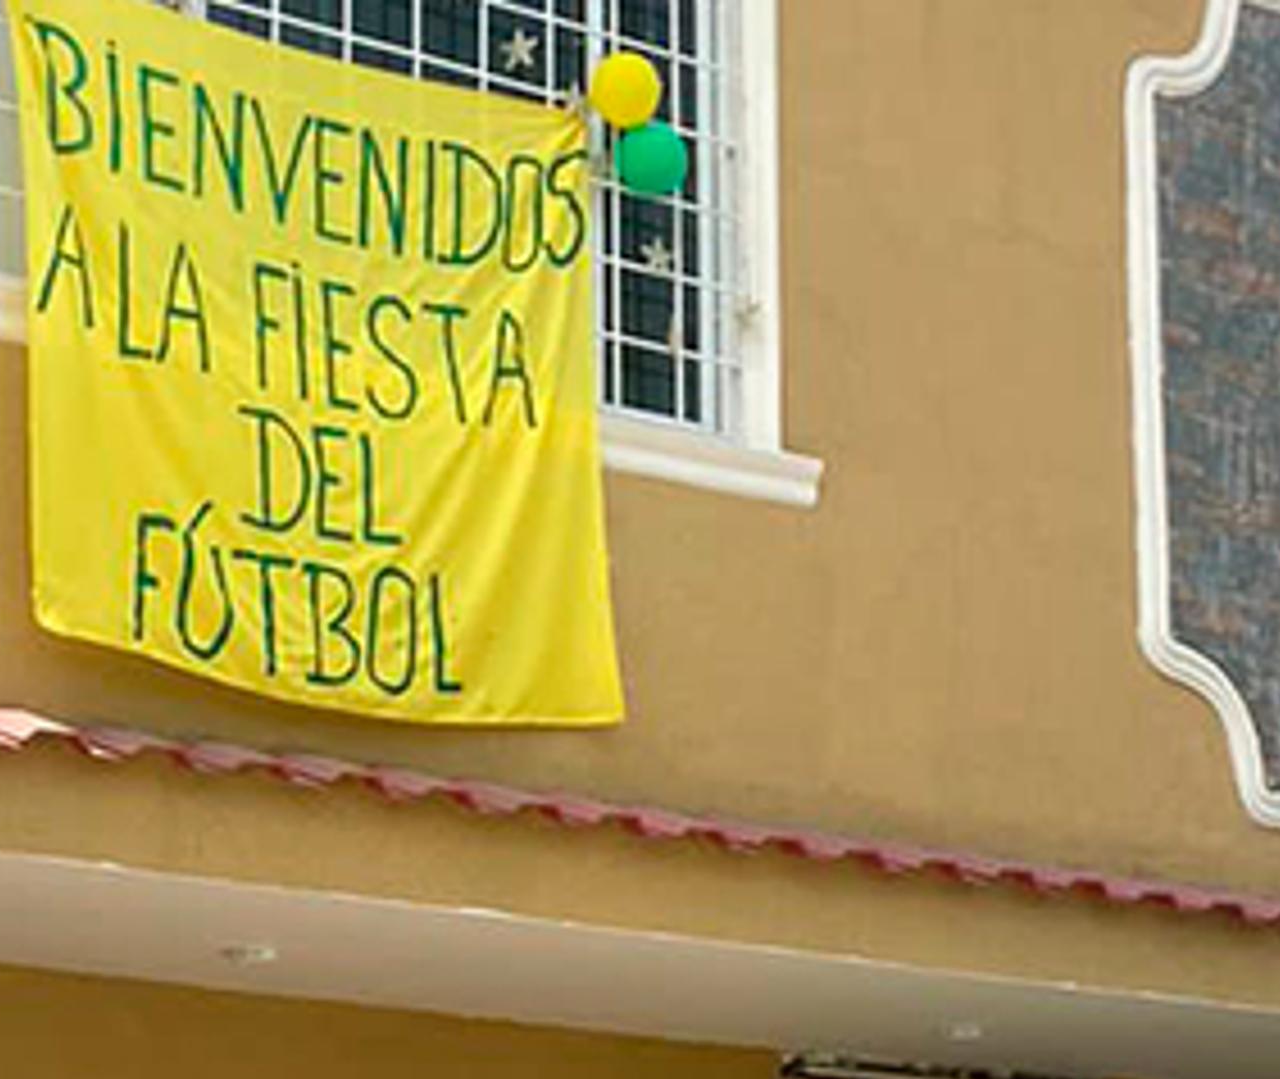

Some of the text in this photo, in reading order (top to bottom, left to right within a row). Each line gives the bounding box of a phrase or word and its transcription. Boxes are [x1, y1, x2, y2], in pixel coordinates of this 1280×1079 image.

[26, 20, 588, 274] BIENVENIDOS
[37, 205, 538, 429] A LA FIESTA
[238, 405, 404, 546] DEL
[131, 501, 463, 696] FÚTBOL
